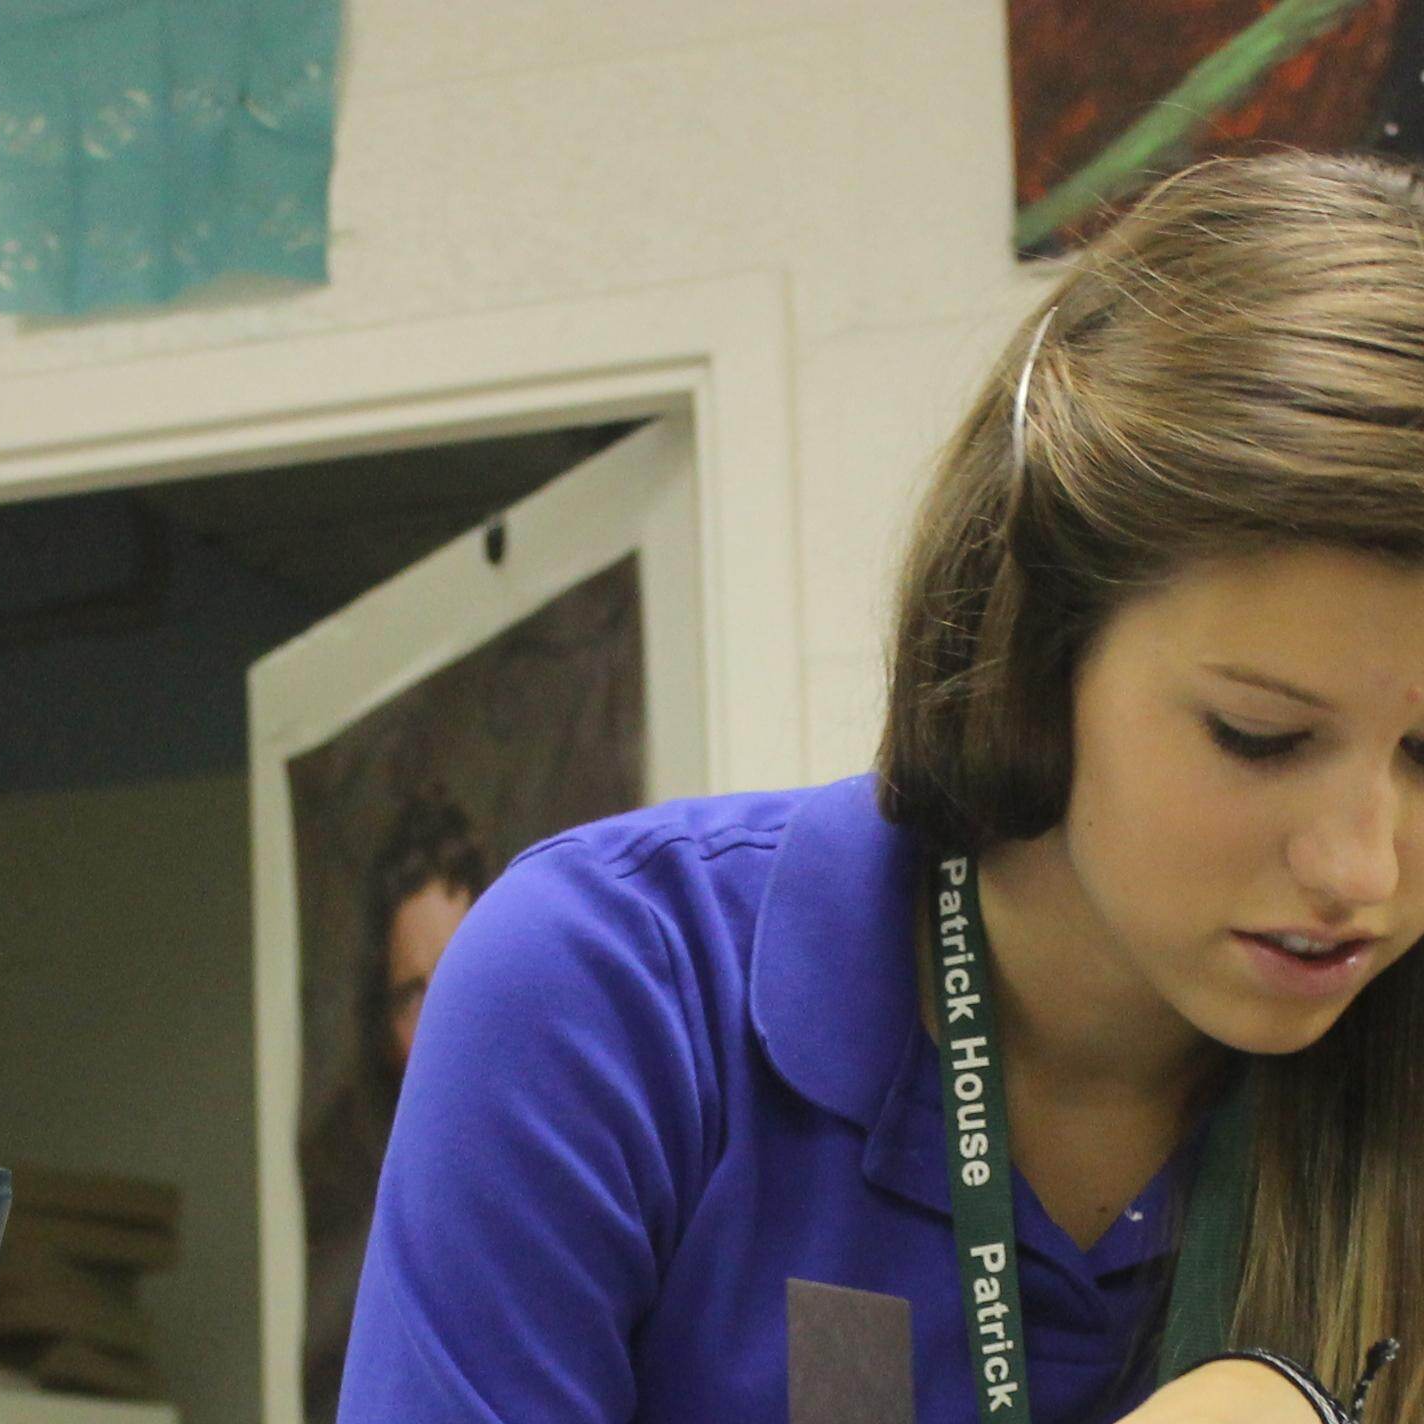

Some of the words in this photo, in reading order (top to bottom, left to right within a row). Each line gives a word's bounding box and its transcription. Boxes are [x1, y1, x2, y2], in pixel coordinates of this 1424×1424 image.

[939, 857, 980, 1024] Patrick
[950, 1035, 991, 1187] House
[970, 1243, 1020, 1410] Patrick
